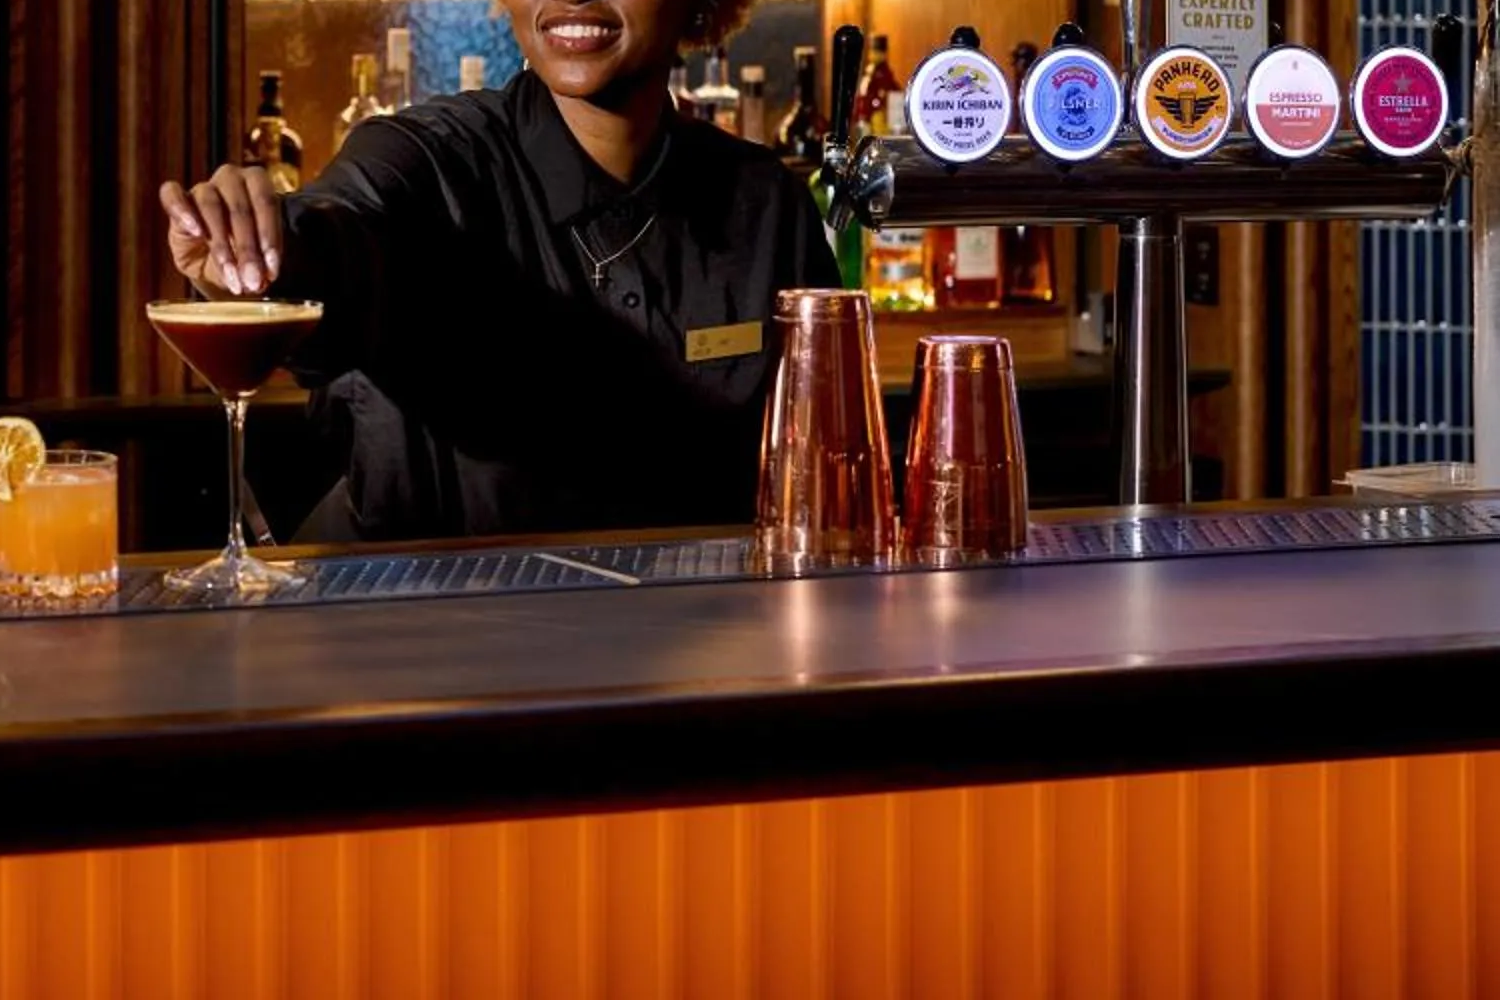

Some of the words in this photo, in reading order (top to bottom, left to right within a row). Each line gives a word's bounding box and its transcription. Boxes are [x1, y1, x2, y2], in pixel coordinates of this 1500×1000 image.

[1182, 12, 1255, 30] CRAFTED
[1154, 61, 1220, 92] PANHEAD
[1269, 91, 1323, 102] ESPRESSO
[1379, 95, 1429, 107] ESTRELLA
[923, 100, 955, 111] KIRIN
[957, 99, 1003, 111] ICHIBAN
[1271, 107, 1321, 118] MARTINI
